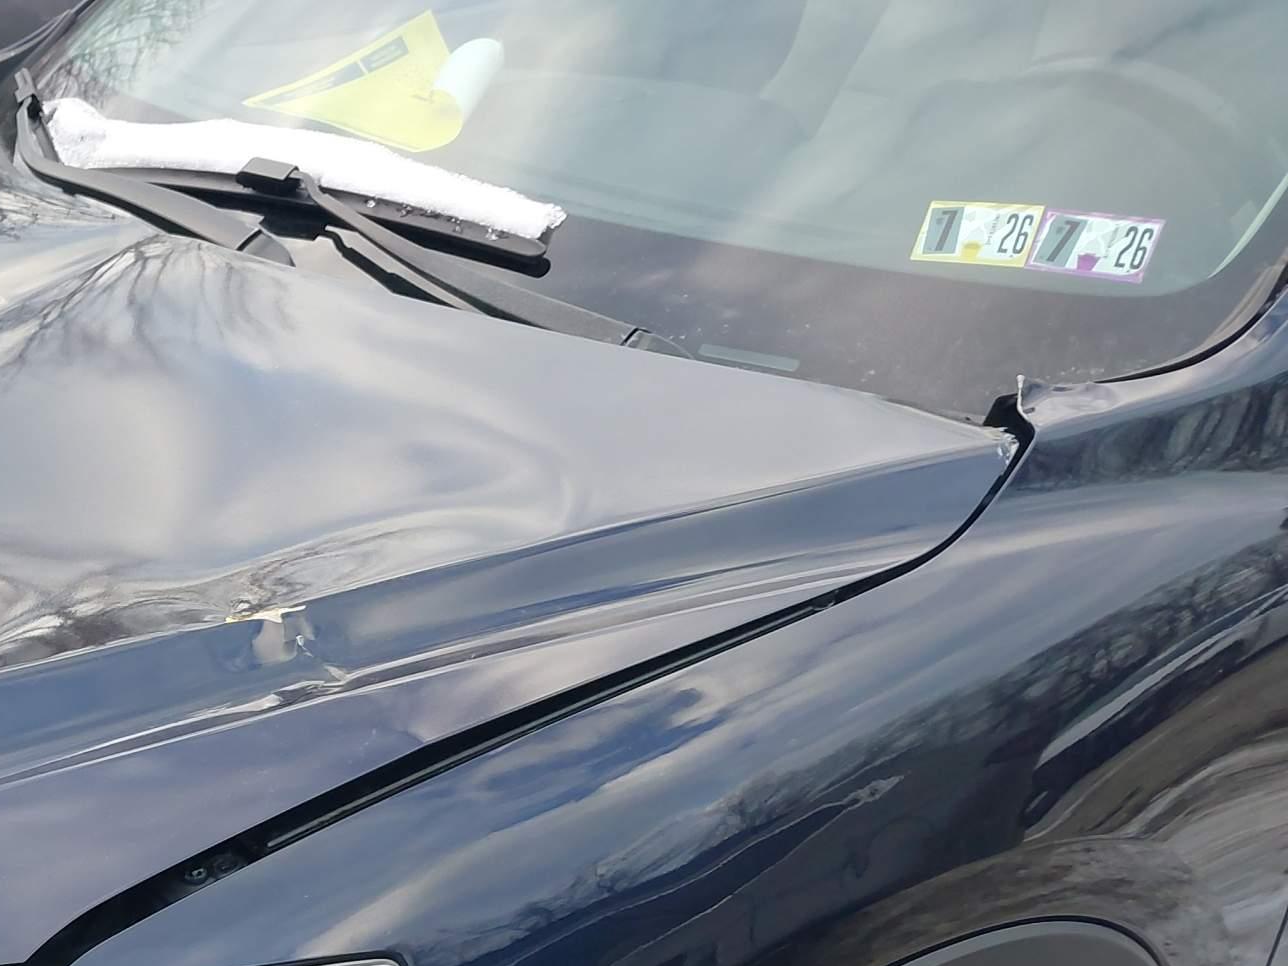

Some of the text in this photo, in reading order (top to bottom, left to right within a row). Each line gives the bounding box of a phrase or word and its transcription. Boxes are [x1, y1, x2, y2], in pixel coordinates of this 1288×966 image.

[934, 210, 958, 252] 7
[997, 213, 1034, 255] 26
[1046, 220, 1081, 262] 7
[1114, 226, 1154, 270] 26
